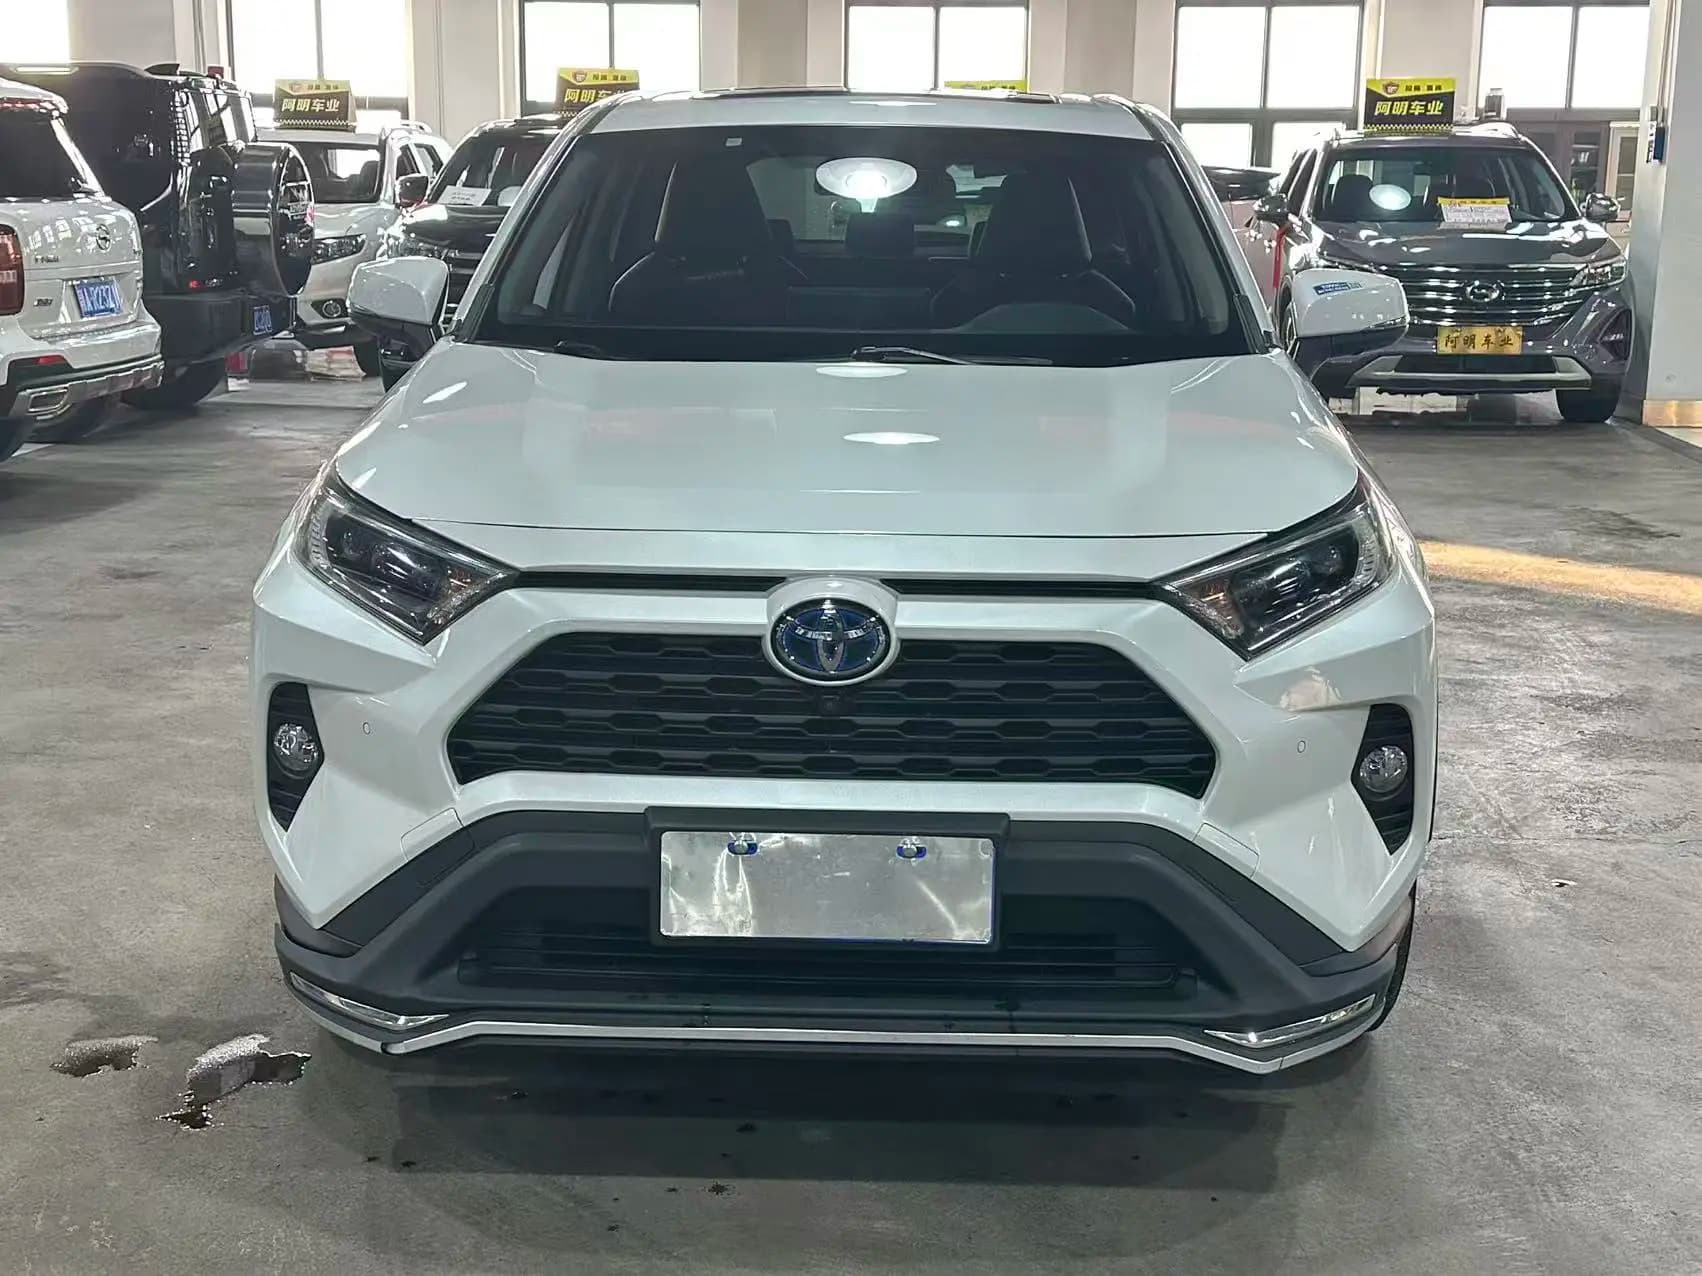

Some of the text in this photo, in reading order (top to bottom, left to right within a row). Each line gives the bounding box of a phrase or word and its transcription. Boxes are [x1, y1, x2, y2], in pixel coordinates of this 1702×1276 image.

[564, 88, 625, 103] 阿明车
[281, 98, 340, 112] 阿明车业
[1374, 100, 1444, 116] 阿明车业
[1444, 334, 1514, 350] 阿明车业
